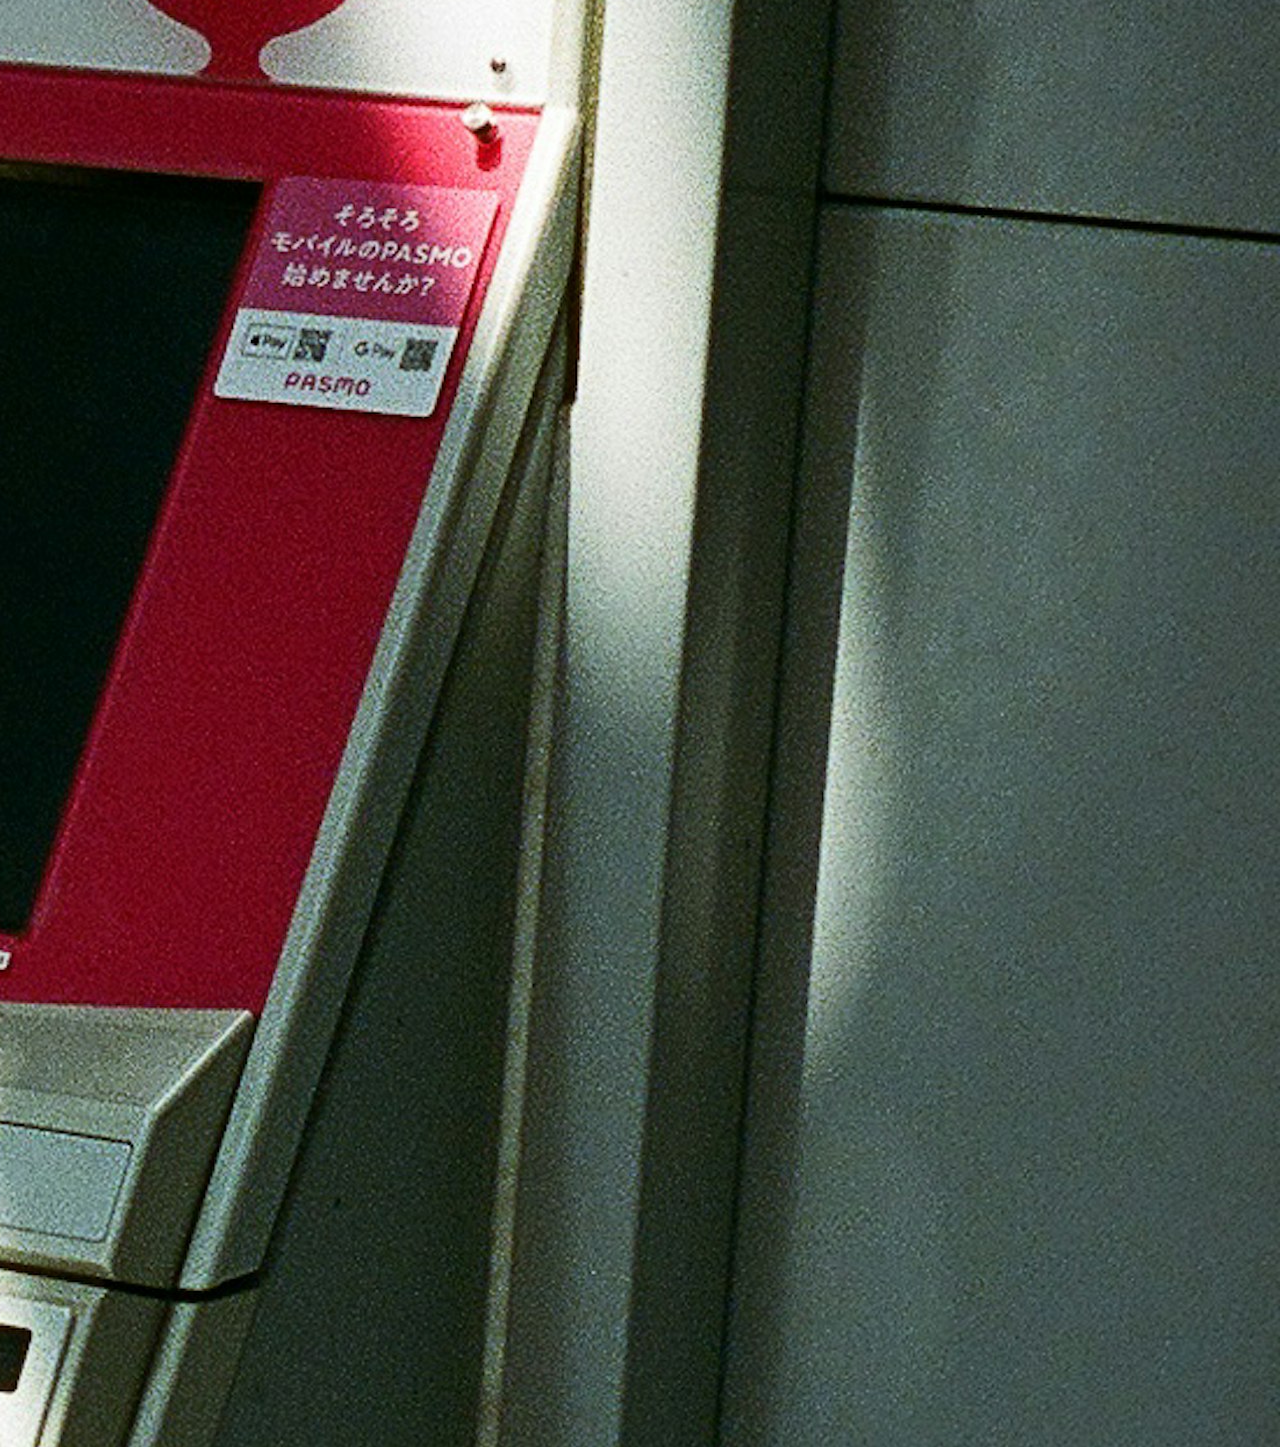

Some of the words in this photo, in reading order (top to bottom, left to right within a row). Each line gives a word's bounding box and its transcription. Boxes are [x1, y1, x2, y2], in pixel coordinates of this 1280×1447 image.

[334, 203, 420, 231] そろそろ
[270, 232, 472, 269] モバイルのPASMO
[282, 261, 435, 297] 始めませんか?
[284, 370, 372, 397] PASMO
